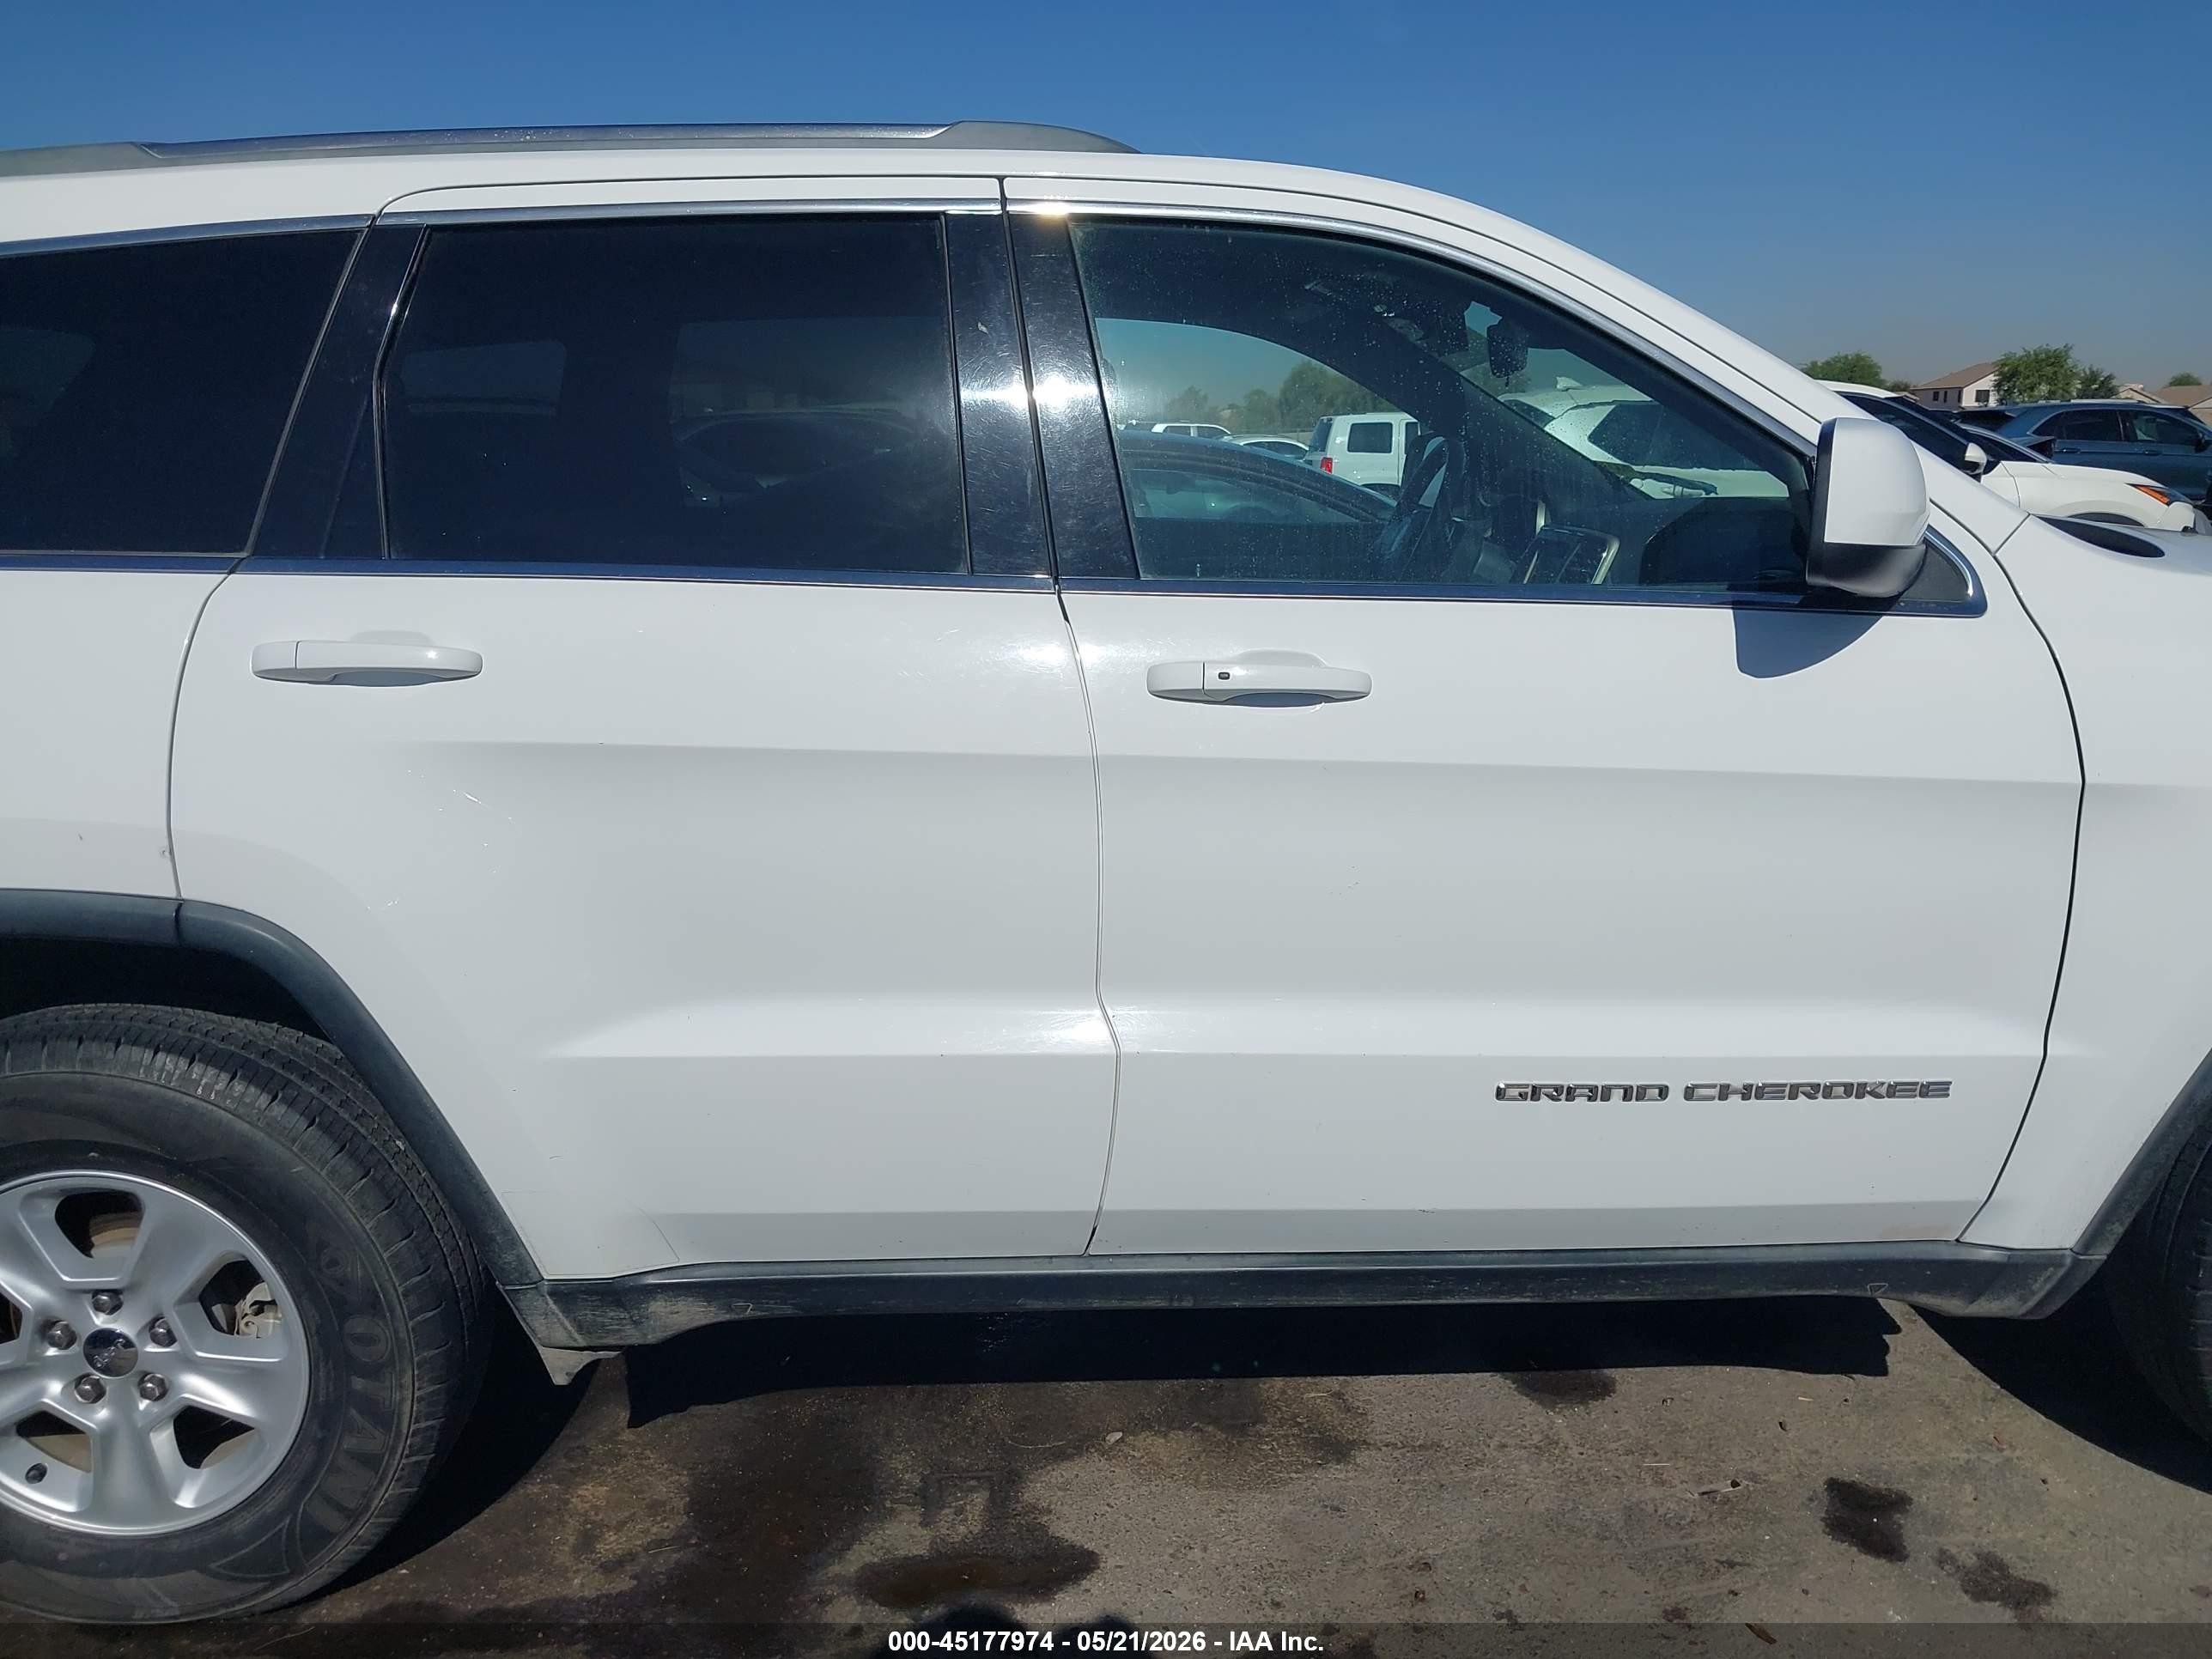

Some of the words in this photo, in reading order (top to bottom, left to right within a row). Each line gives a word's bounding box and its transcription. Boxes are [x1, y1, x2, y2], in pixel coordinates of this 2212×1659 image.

[1495, 1082, 1669, 1103] GRAND
[1683, 1080, 1954, 1102] CHEROKEE
[307, 1314, 394, 1534] OTANI
